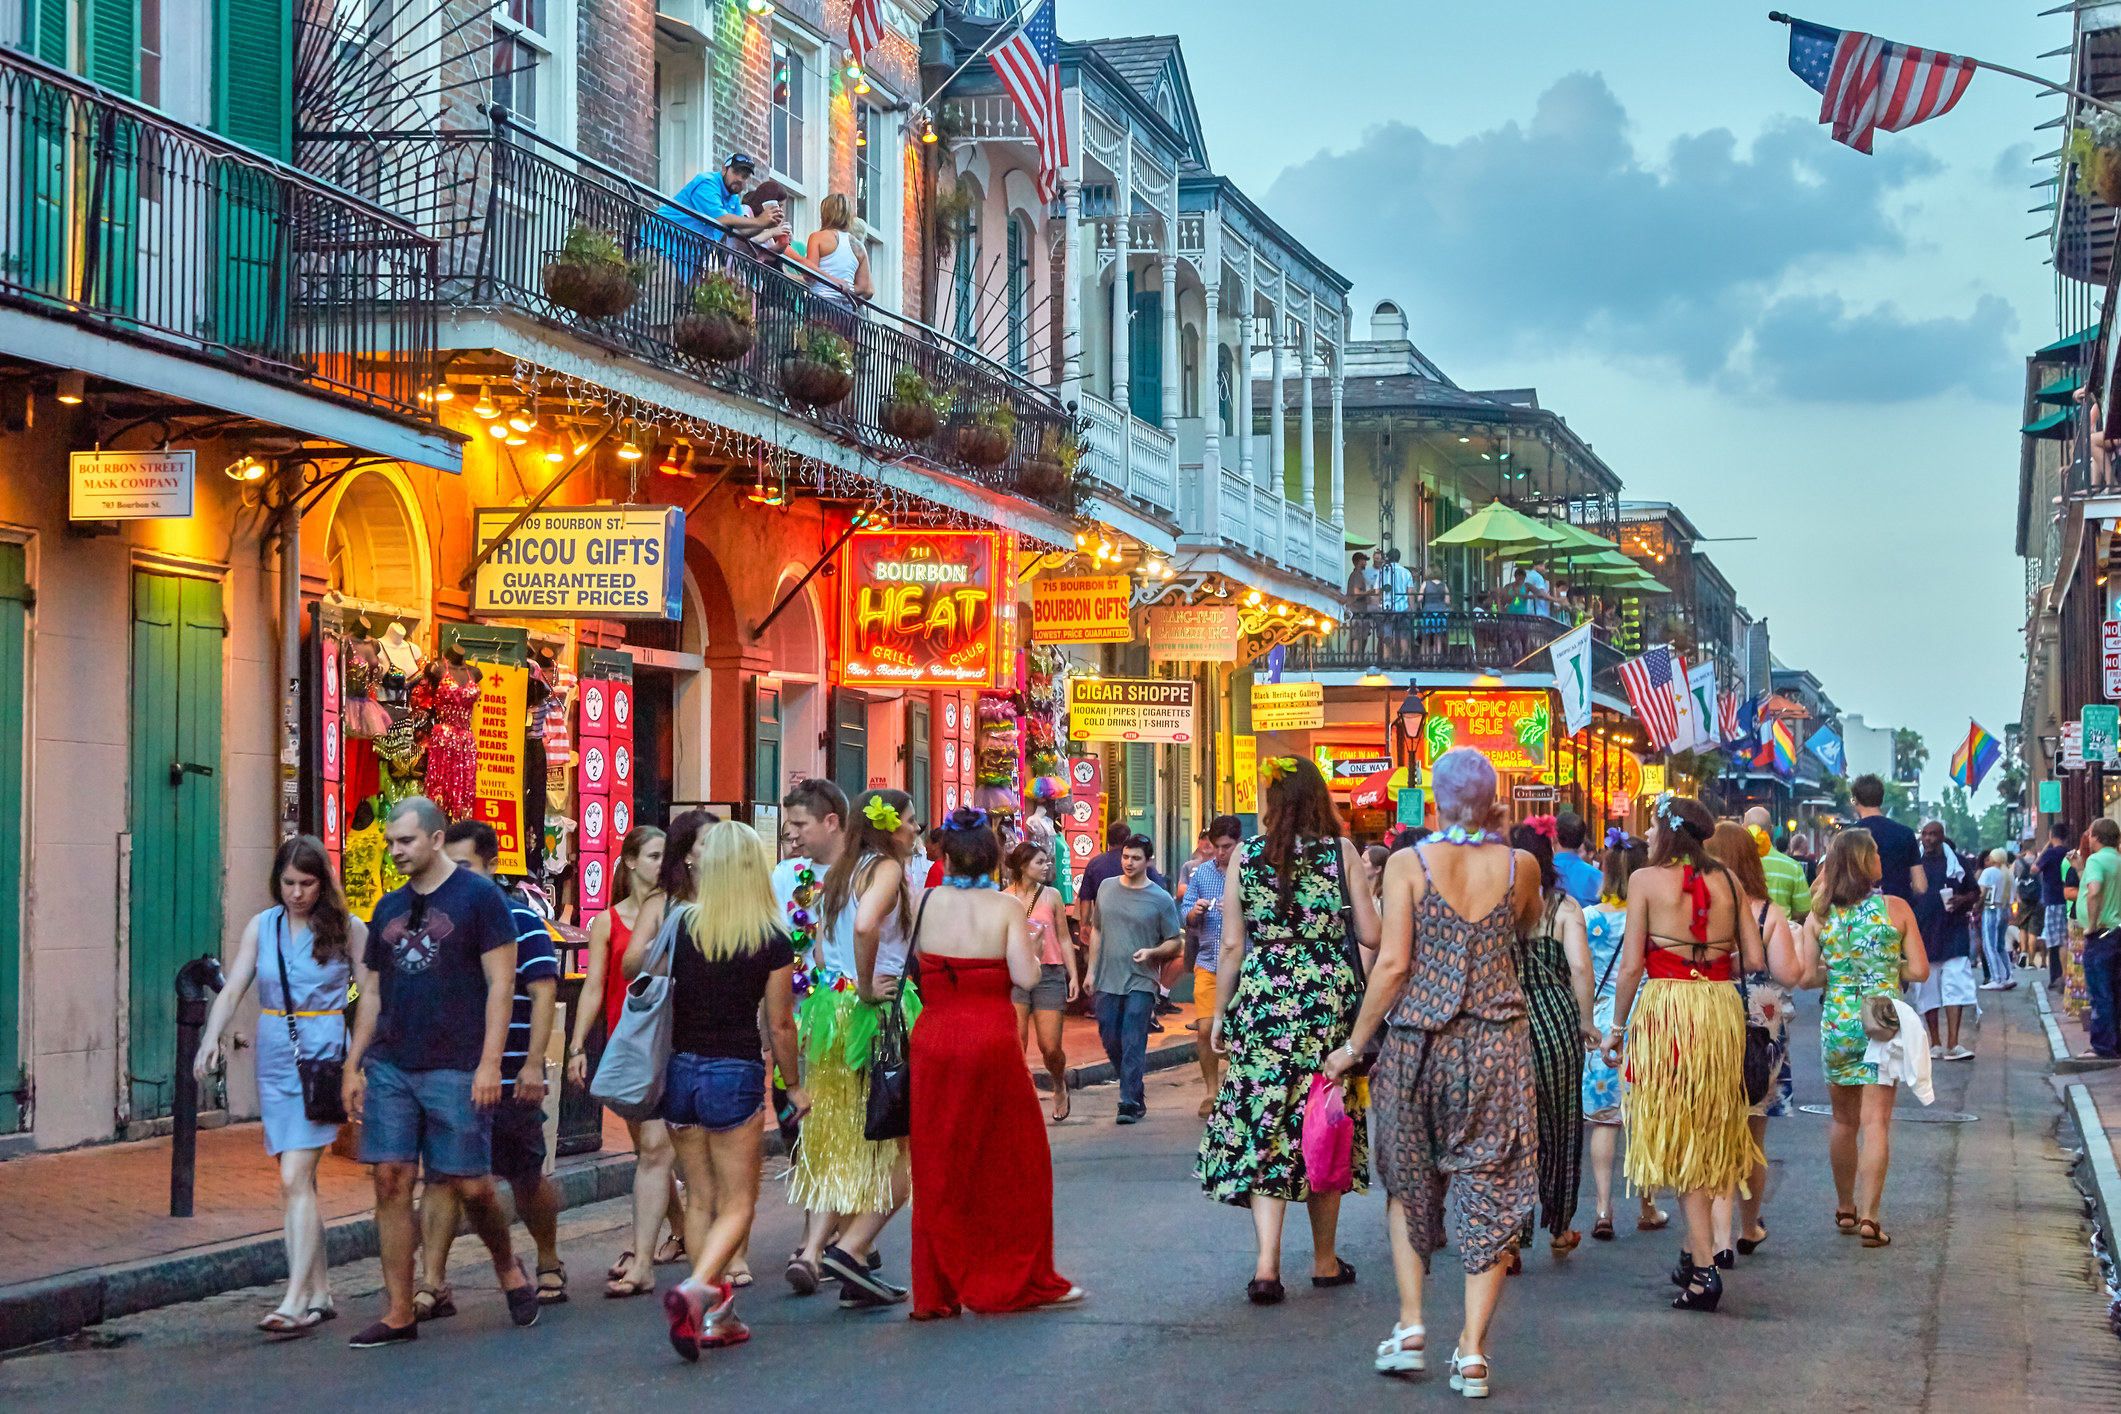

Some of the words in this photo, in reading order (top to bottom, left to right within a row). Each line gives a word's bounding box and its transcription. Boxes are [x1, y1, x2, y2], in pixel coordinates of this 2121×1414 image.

[80, 463, 136, 474] BOURBON
[140, 462, 186, 472] STREET
[84, 480, 118, 488] MASK
[120, 478, 180, 488] COMPANY
[546, 518, 602, 529] BOURBON
[606, 518, 624, 530] ST.
[482, 538, 576, 565] TRICOU
[586, 538, 660, 565] GIFTS
[910, 547, 930, 558] 711
[876, 562, 968, 582] BOURBON
[503, 573, 636, 588] GUARANTEED
[1043, 582, 1057, 592] 715
[1060, 580, 1104, 591] BOURBON
[1107, 580, 1118, 589] ST
[490, 590, 569, 605] LOWEST
[577, 590, 648, 606] PRICES
[1034, 598, 1090, 622] BOURBON
[1094, 596, 1128, 620] GIFTS
[858, 586, 988, 651] HEAT
[1034, 630, 1061, 640] LOWEST
[1064, 629, 1082, 638] PRICE
[1084, 628, 1129, 638] GUARANTEED
[1208, 626, 1231, 639] INC.
[2105, 626, 2118, 636] NO
[872, 646, 915, 666] GRILL
[950, 642, 985, 666] CLUB
[2105, 657, 2118, 667] NO
[876, 664, 924, 679] Balcony
[930, 664, 986, 679] Courtyard
[1076, 684, 1123, 700] CIGAR
[1128, 685, 1189, 702] SHOPPE
[1273, 692, 1296, 700] Heritage
[1300, 690, 1320, 698] Gallery
[484, 694, 506, 704] BOAS
[482, 706, 507, 716] MUGS
[593, 705, 597, 717] 1
[620, 708, 624, 719] 1
[1074, 707, 1106, 715] HOOKAH
[1142, 708, 1190, 717] CIGARETTES
[1444, 700, 1529, 717] TROPICAL
[482, 717, 506, 727] HATS
[1084, 718, 1104, 726] COLD
[1107, 718, 1136, 726] DRINKS
[1144, 720, 1180, 728] T-SHIRTS
[1469, 718, 1503, 734] ISLE
[479, 729, 508, 739] MASKS
[479, 740, 507, 751] BEADS
[477, 752, 515, 763] OUVENIR
[1340, 751, 1356, 759] COME
[487, 764, 515, 774] CHAINS
[592, 766, 597, 777] 2
[620, 763, 625, 774] 2
[1370, 764, 1386, 772] WAY
[481, 780, 507, 788] WHITE
[1236, 775, 1256, 803] 50%
[476, 788, 514, 798] -SHIRTS
[1517, 789, 1551, 798] Orleans
[485, 800, 499, 818] 5
[1075, 803, 1090, 814] RINCESS
[1247, 801, 1256, 810] OFF
[587, 805, 600, 818] BITCH
[490, 821, 507, 831] OR
[591, 821, 597, 832] 3
[619, 819, 624, 829] 3
[498, 858, 518, 867] RICES
[587, 863, 600, 876] BITCH
[591, 880, 596, 891] 4
